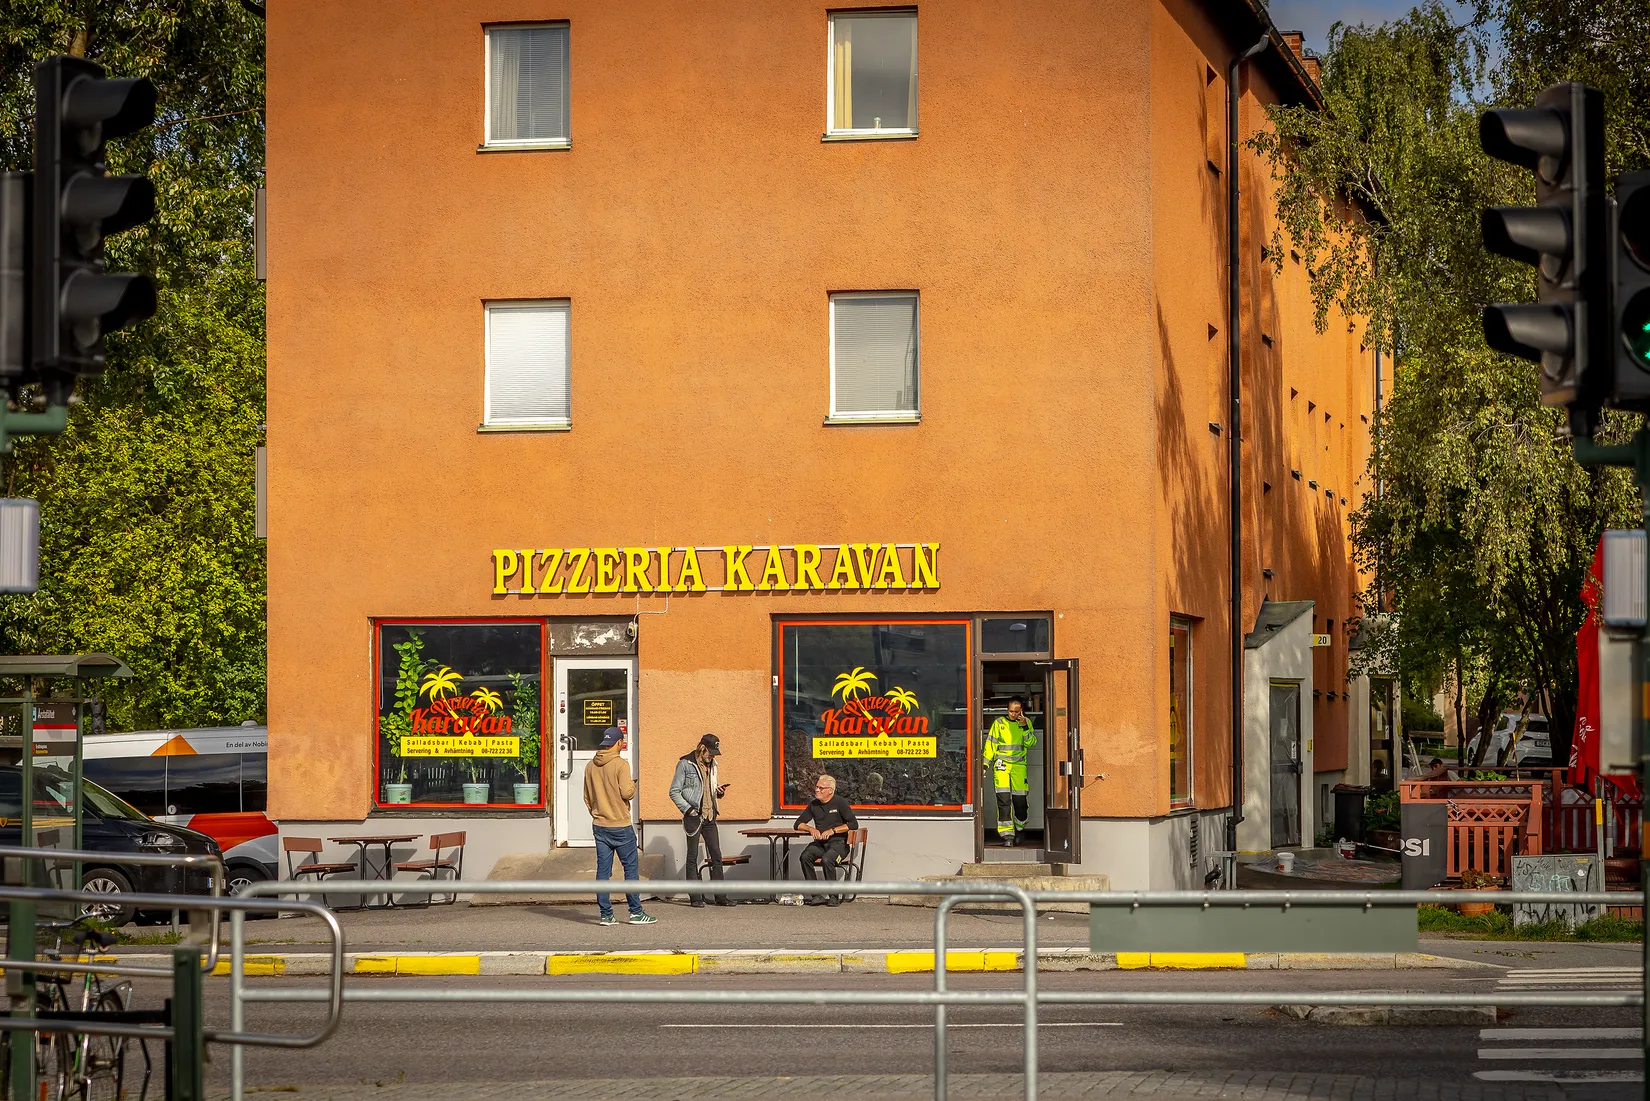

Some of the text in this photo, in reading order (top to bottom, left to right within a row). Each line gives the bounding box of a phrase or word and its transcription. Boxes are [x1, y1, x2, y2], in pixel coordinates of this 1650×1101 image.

[493, 542, 940, 594] PIZZERIA KARAVAN
[1318, 636, 1327, 645] 20
[430, 696, 490, 716] Pizzeria
[842, 696, 905, 717] Pizzeria
[409, 708, 513, 734] Karavan
[821, 708, 929, 735] Karavan
[444, 747, 474, 755] Avhämtning
